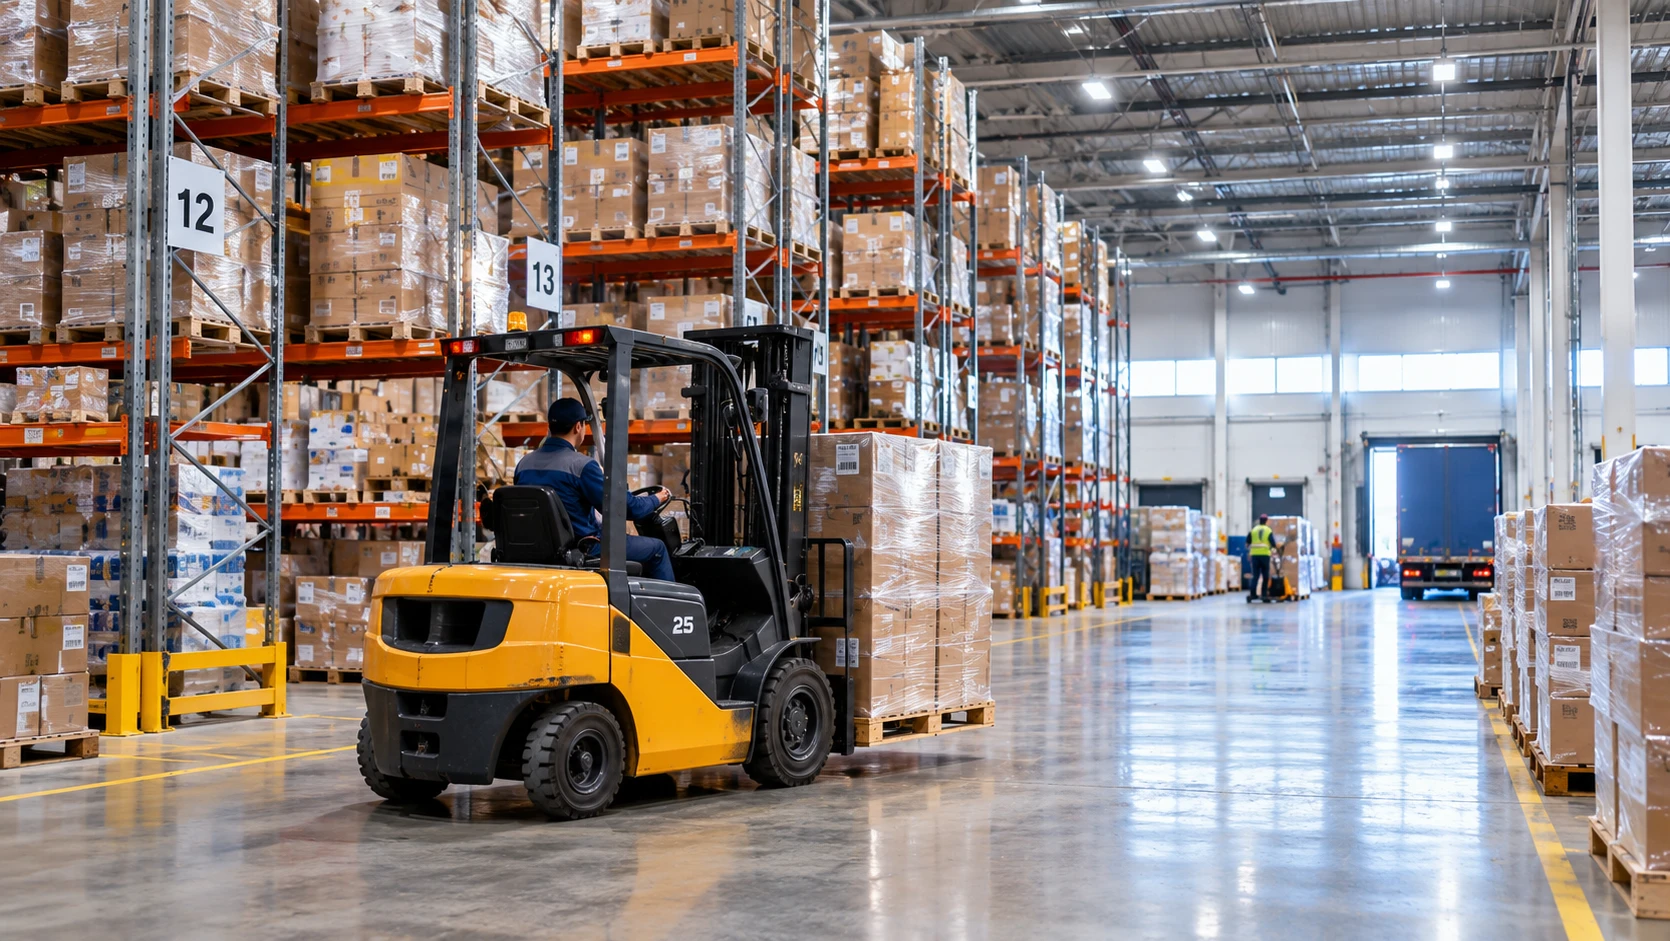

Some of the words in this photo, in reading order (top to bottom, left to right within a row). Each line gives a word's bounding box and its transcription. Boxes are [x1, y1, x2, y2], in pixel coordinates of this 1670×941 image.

[177, 188, 215, 234] 12
[533, 262, 554, 295] 13
[672, 616, 694, 634] 25
